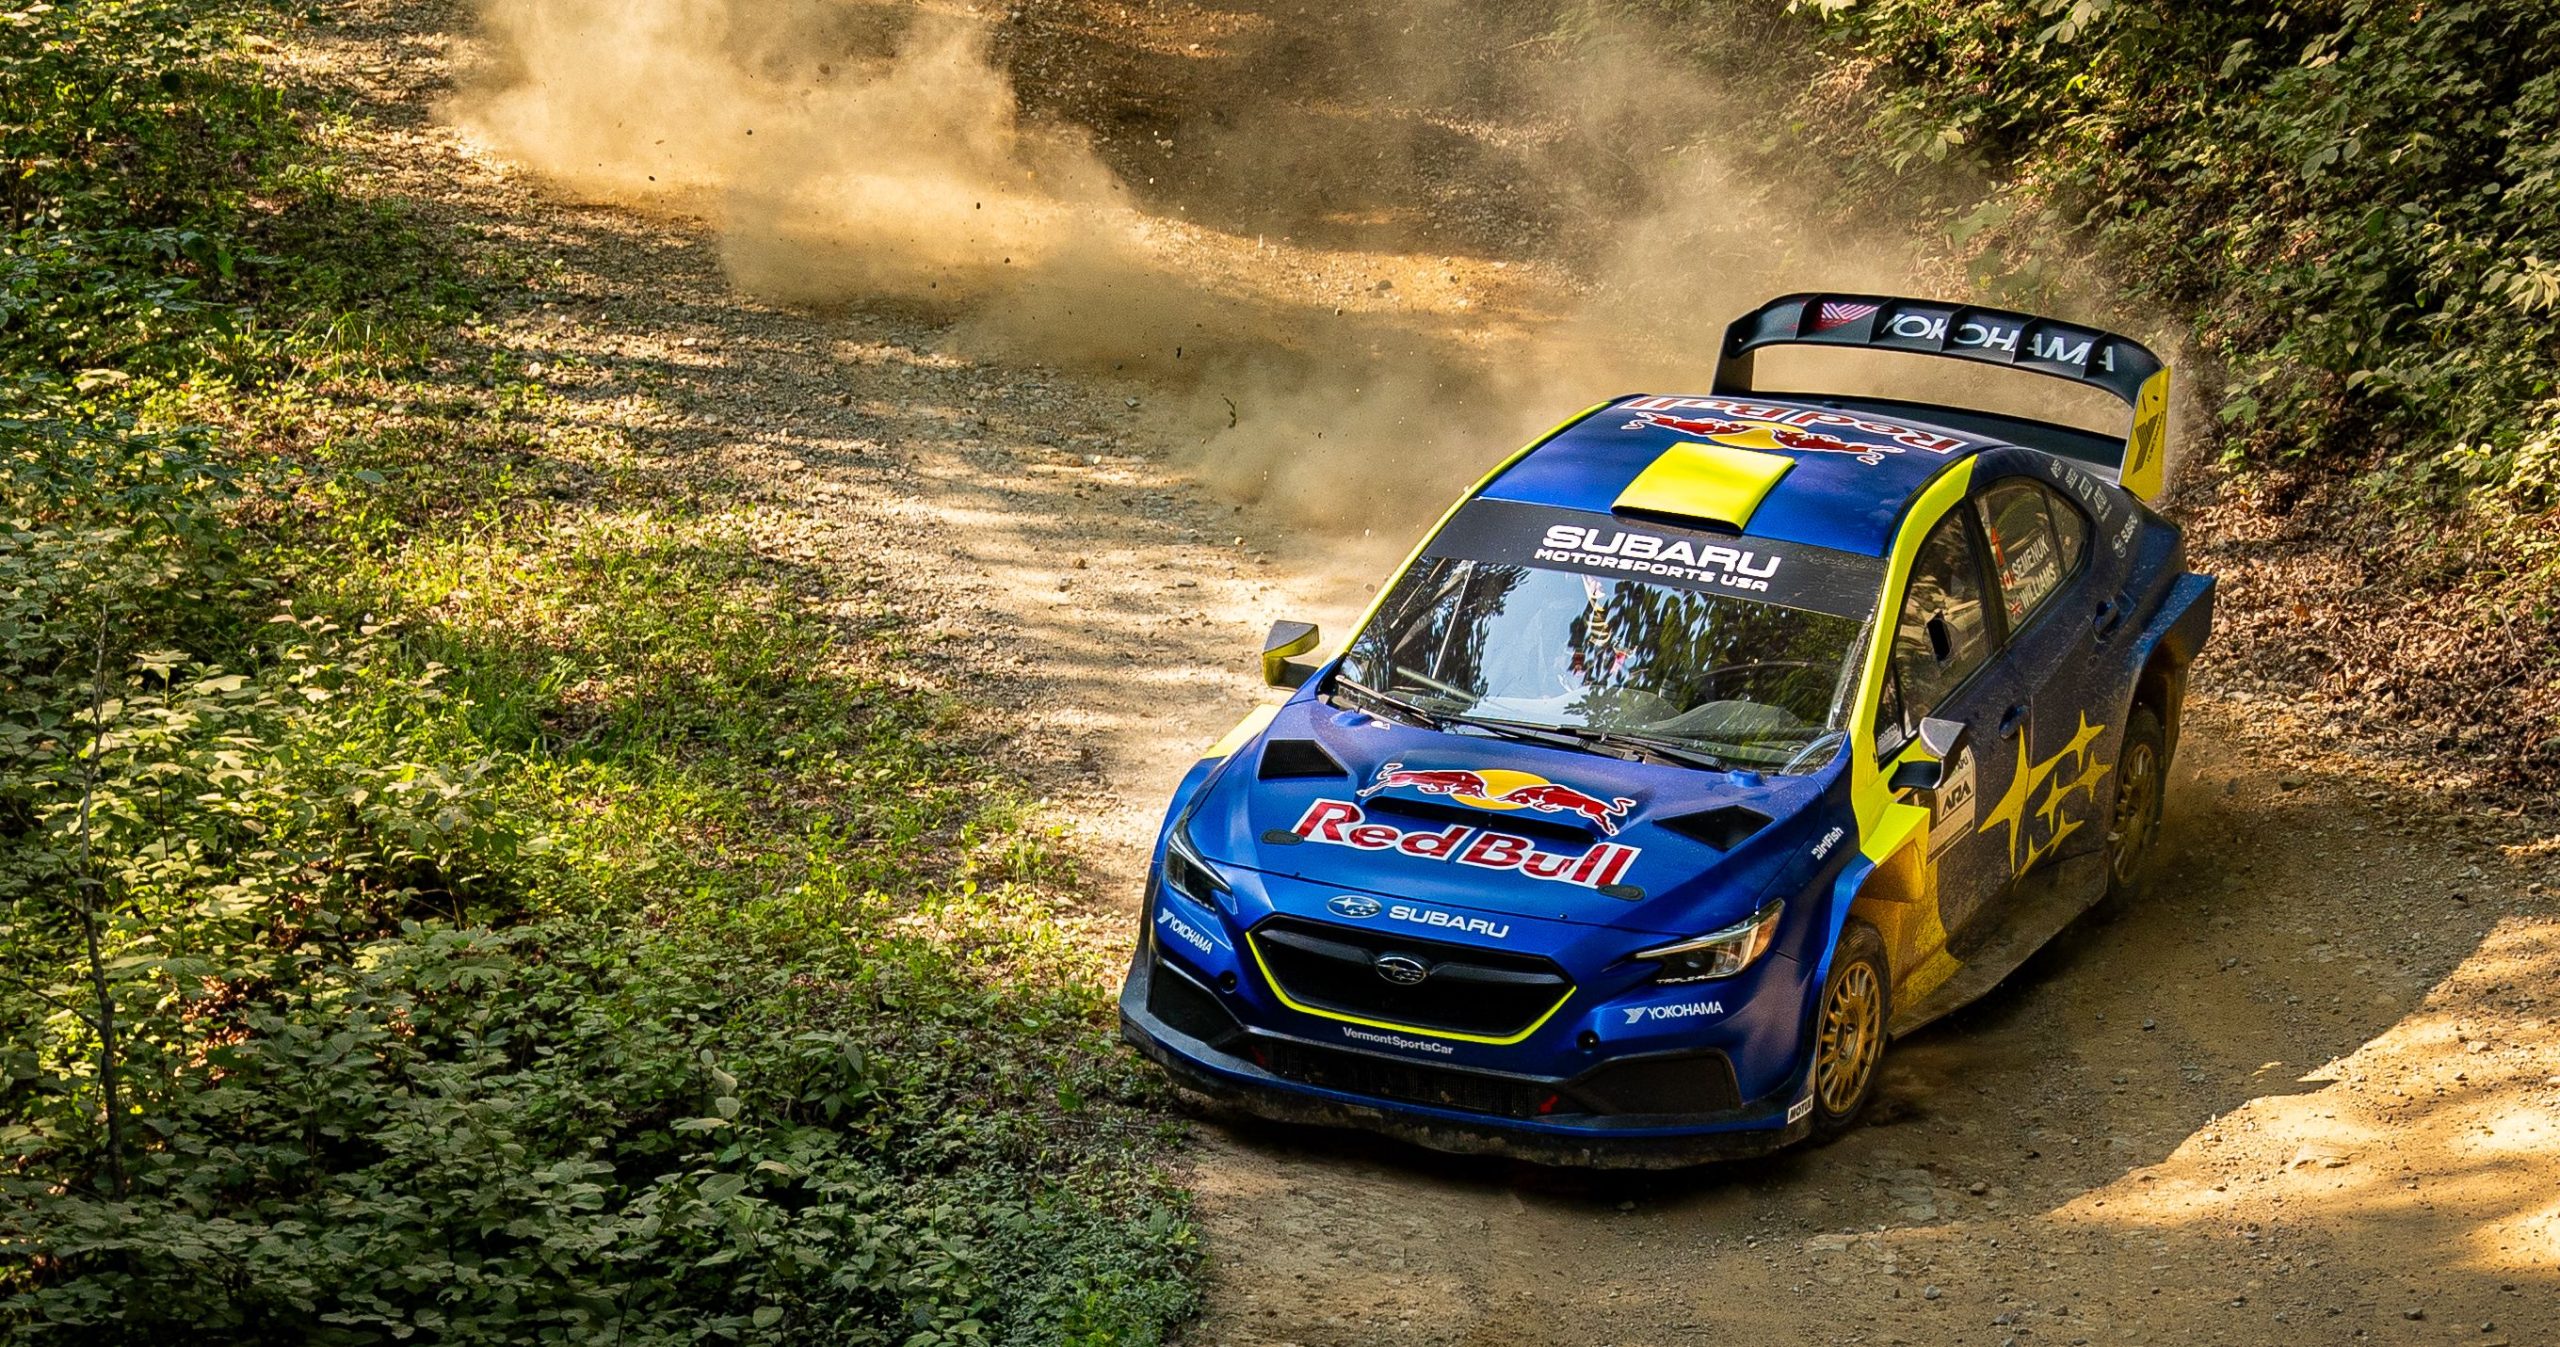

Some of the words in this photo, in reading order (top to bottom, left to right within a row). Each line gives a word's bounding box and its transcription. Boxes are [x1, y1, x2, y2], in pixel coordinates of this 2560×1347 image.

[1618, 396, 1799, 423] Bull
[1783, 410, 1970, 454] Red
[1534, 548, 1715, 584] MOTORSPORTS
[1720, 575, 1769, 593] USA
[1542, 524, 1782, 579] SUBARU
[2011, 533, 2050, 582] SEMENUK
[2019, 561, 2058, 610] WILLIAMS
[1294, 797, 1469, 861] Red
[1456, 830, 1642, 889] Bull
[1168, 917, 1214, 955] YOKOHAMA
[1388, 905, 1510, 939] SUBARU
[1647, 1001, 1724, 1021] YOKOHAMA
[1342, 1026, 1454, 1055] VermontSportsCar
